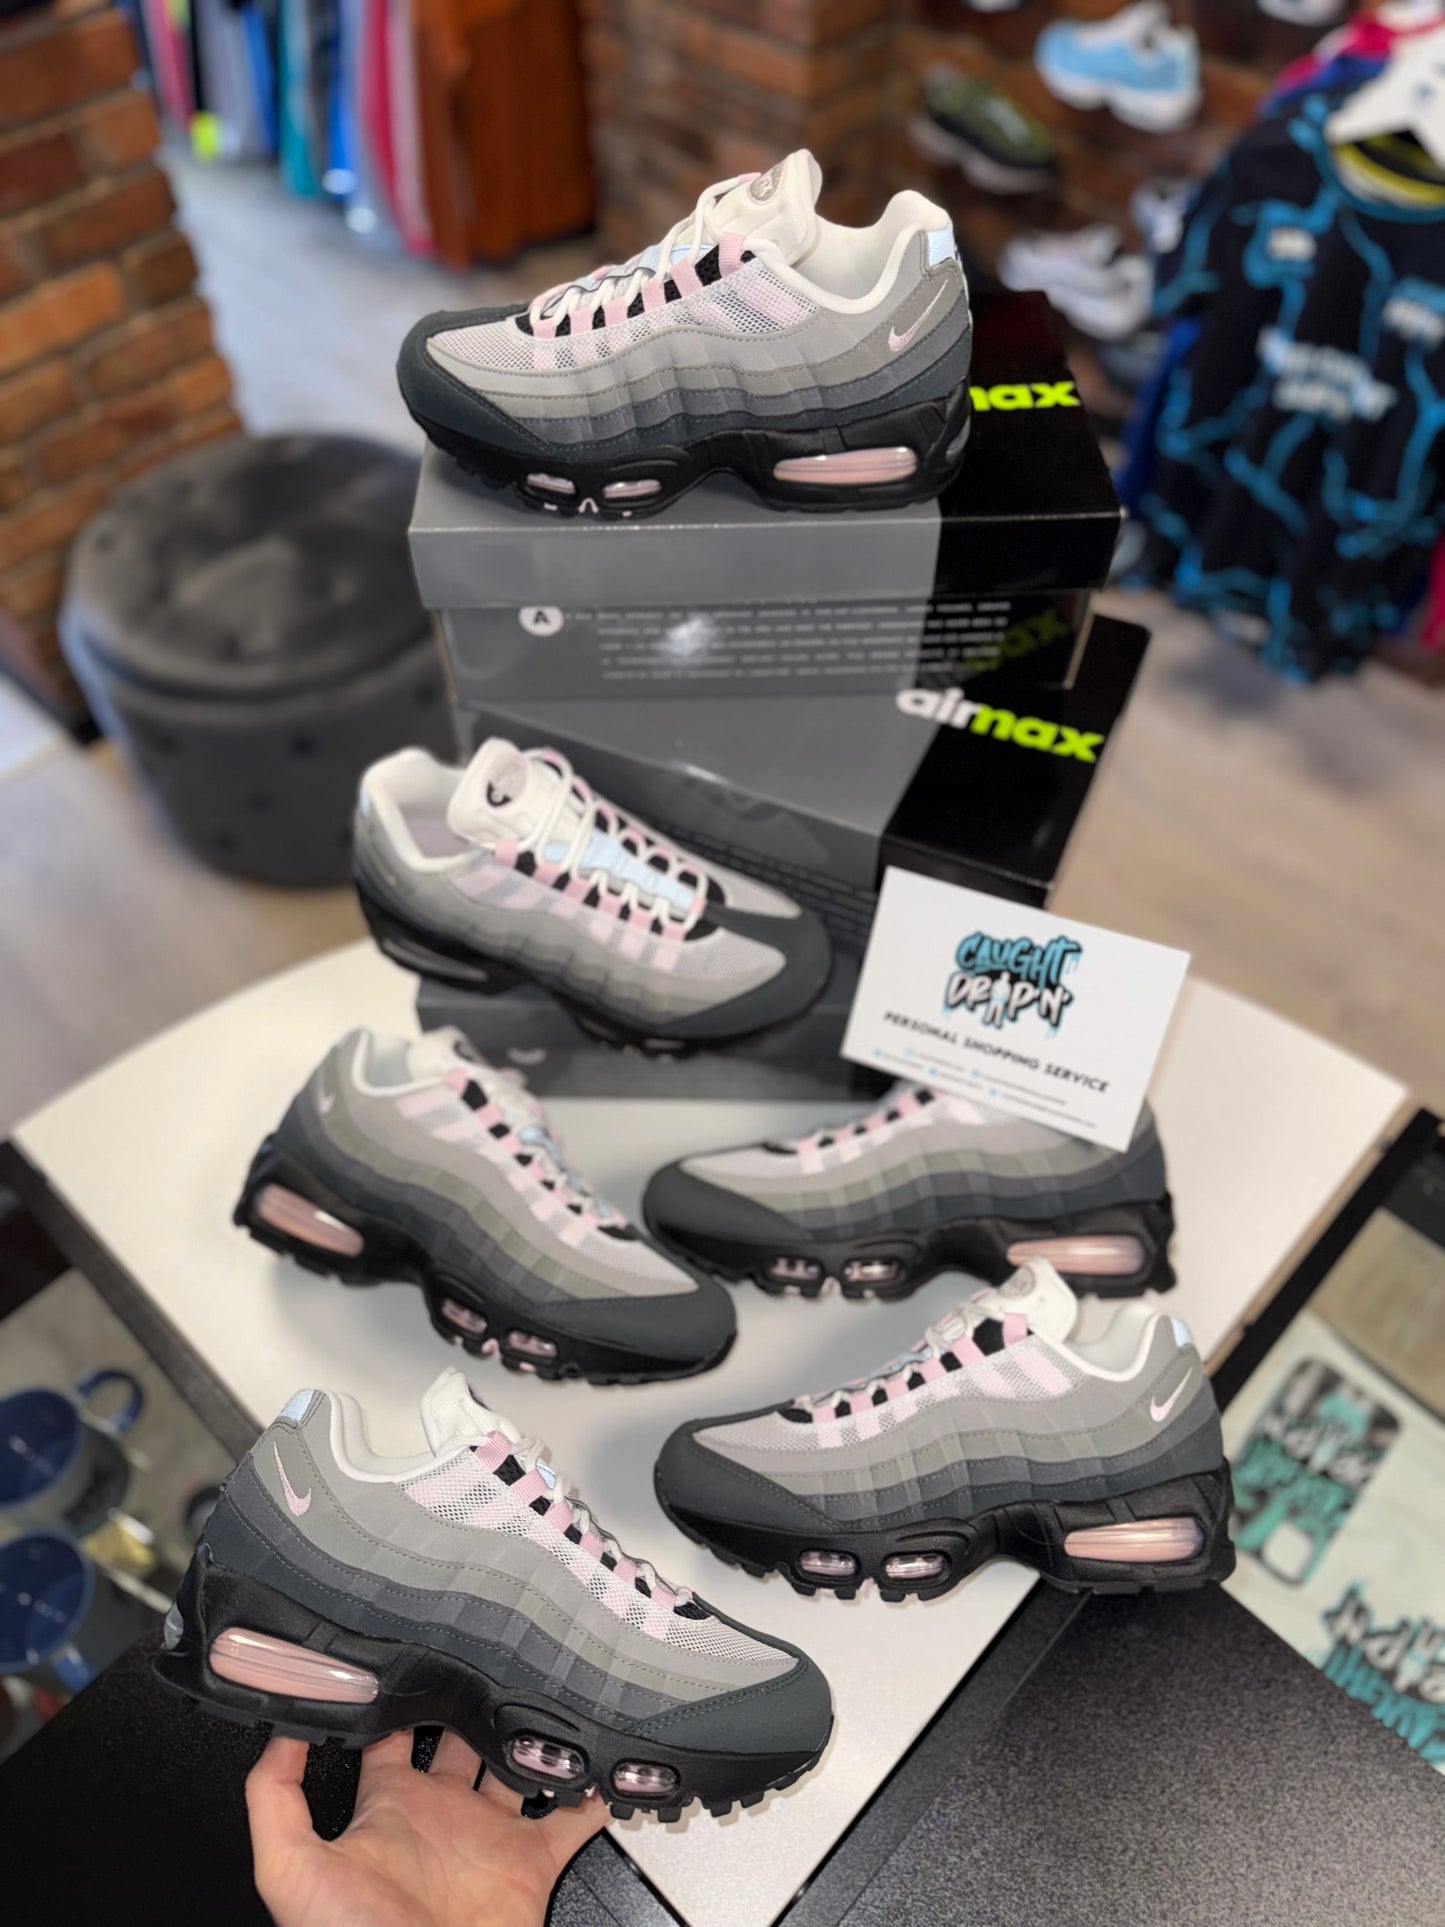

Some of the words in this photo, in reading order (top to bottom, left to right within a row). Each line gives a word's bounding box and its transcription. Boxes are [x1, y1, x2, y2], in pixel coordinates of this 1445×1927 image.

[956, 931, 1083, 988] CAUGHT
[883, 1010, 958, 1044] PERSONAL
[963, 1037, 1040, 1071] SHOPPING
[1044, 1063, 1110, 1093] SERVICE
